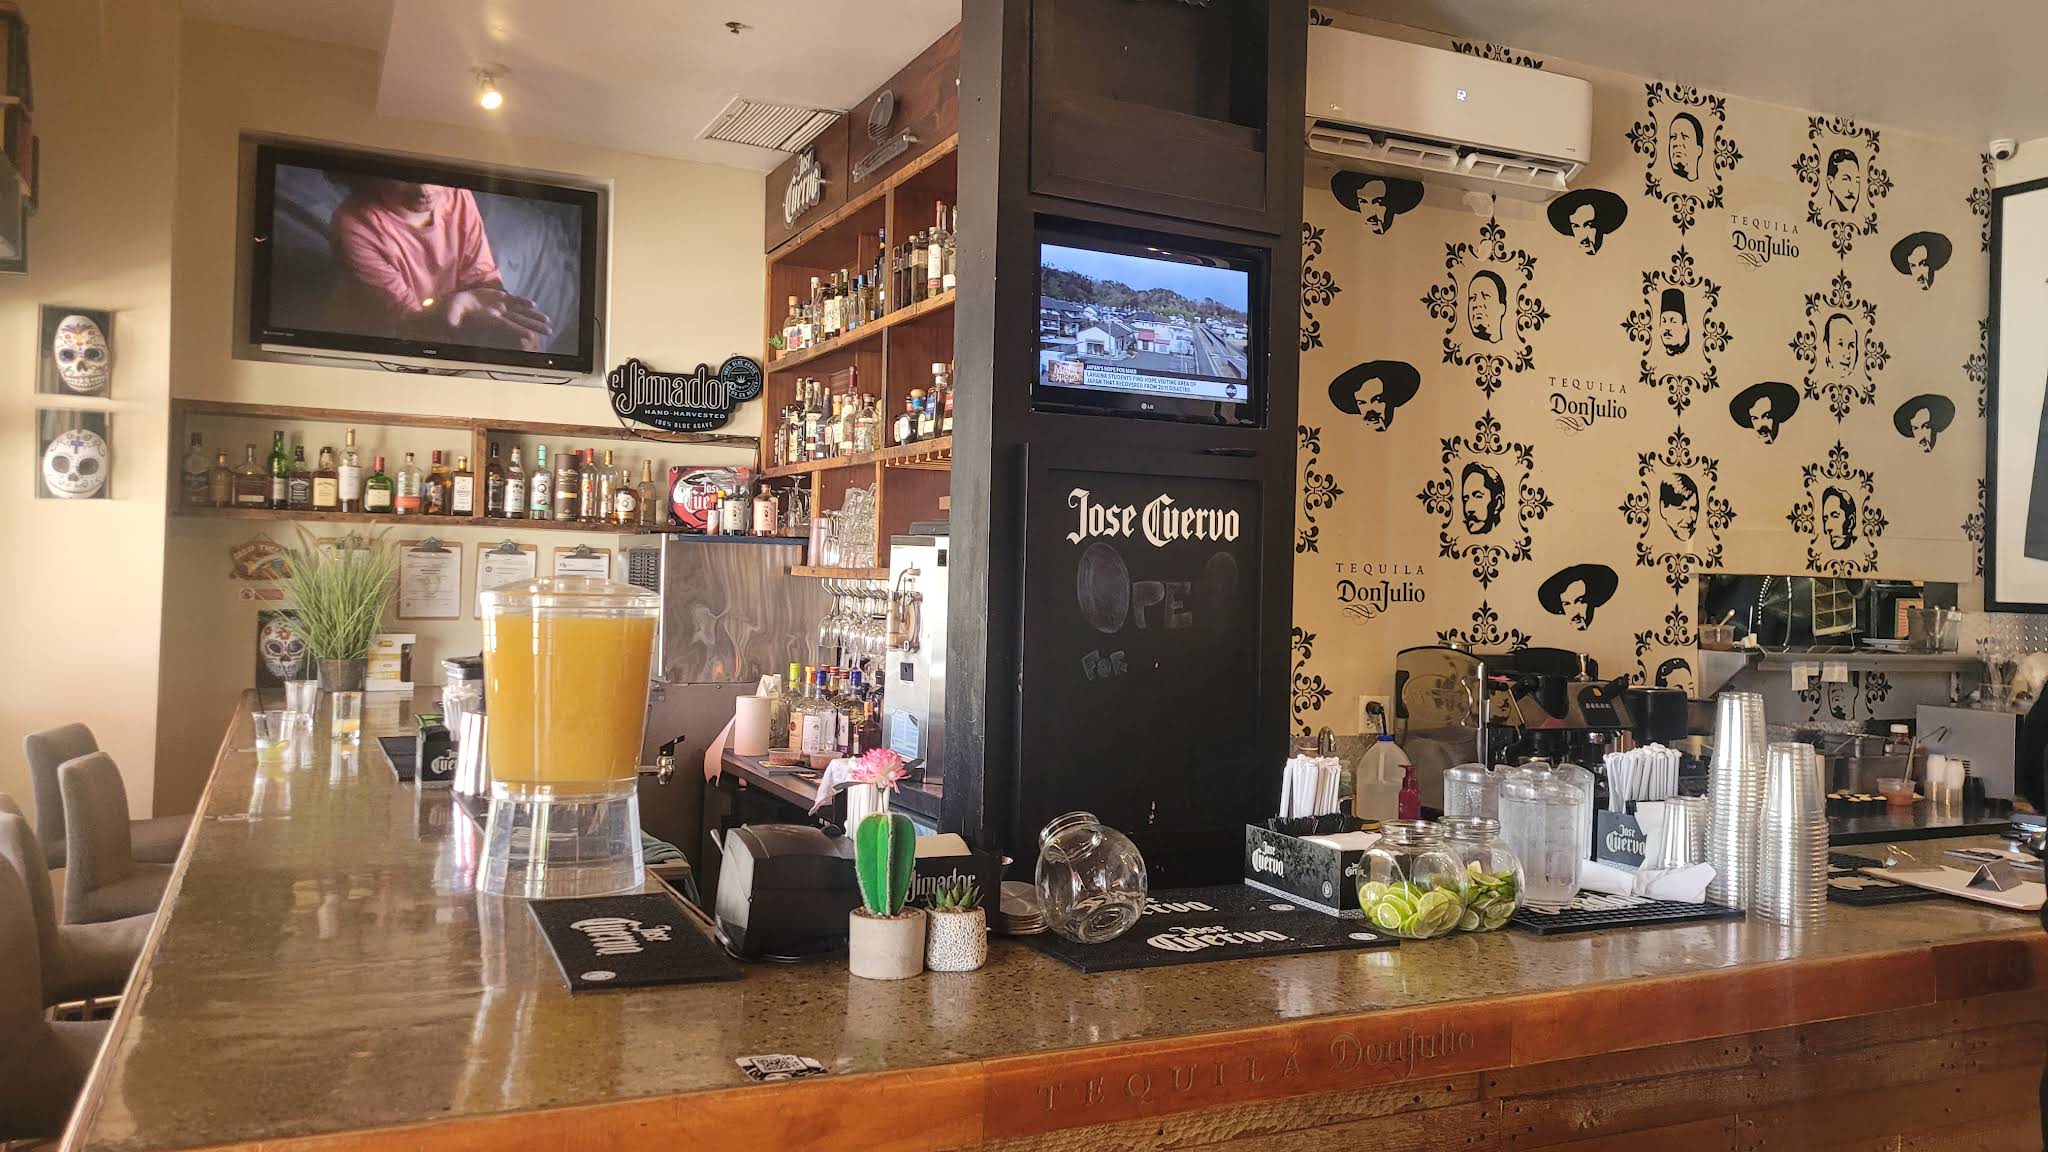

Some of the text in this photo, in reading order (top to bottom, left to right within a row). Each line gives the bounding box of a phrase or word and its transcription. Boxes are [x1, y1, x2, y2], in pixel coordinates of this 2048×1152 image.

[1731, 215, 1799, 234] TEQUILA
[612, 362, 737, 415] el Jimador
[1116, 380, 1143, 388] RECOVERED
[1158, 378, 1177, 386] VISITING
[1548, 377, 1627, 394] TEQUILA
[644, 409, 726, 419] HAND-HARVESTED
[655, 418, 713, 429] 100% BLUE AGAVE
[1066, 487, 1240, 548] Jose Cuervo
[1336, 562, 1425, 576] TEQUILA
[1619, 824, 1636, 838] Jose
[1262, 840, 1276, 856] Jose
[1605, 830, 1646, 856] Cuervo
[1168, 925, 1229, 937] Jose
[1036, 1052, 1301, 1113] TEQUILA
